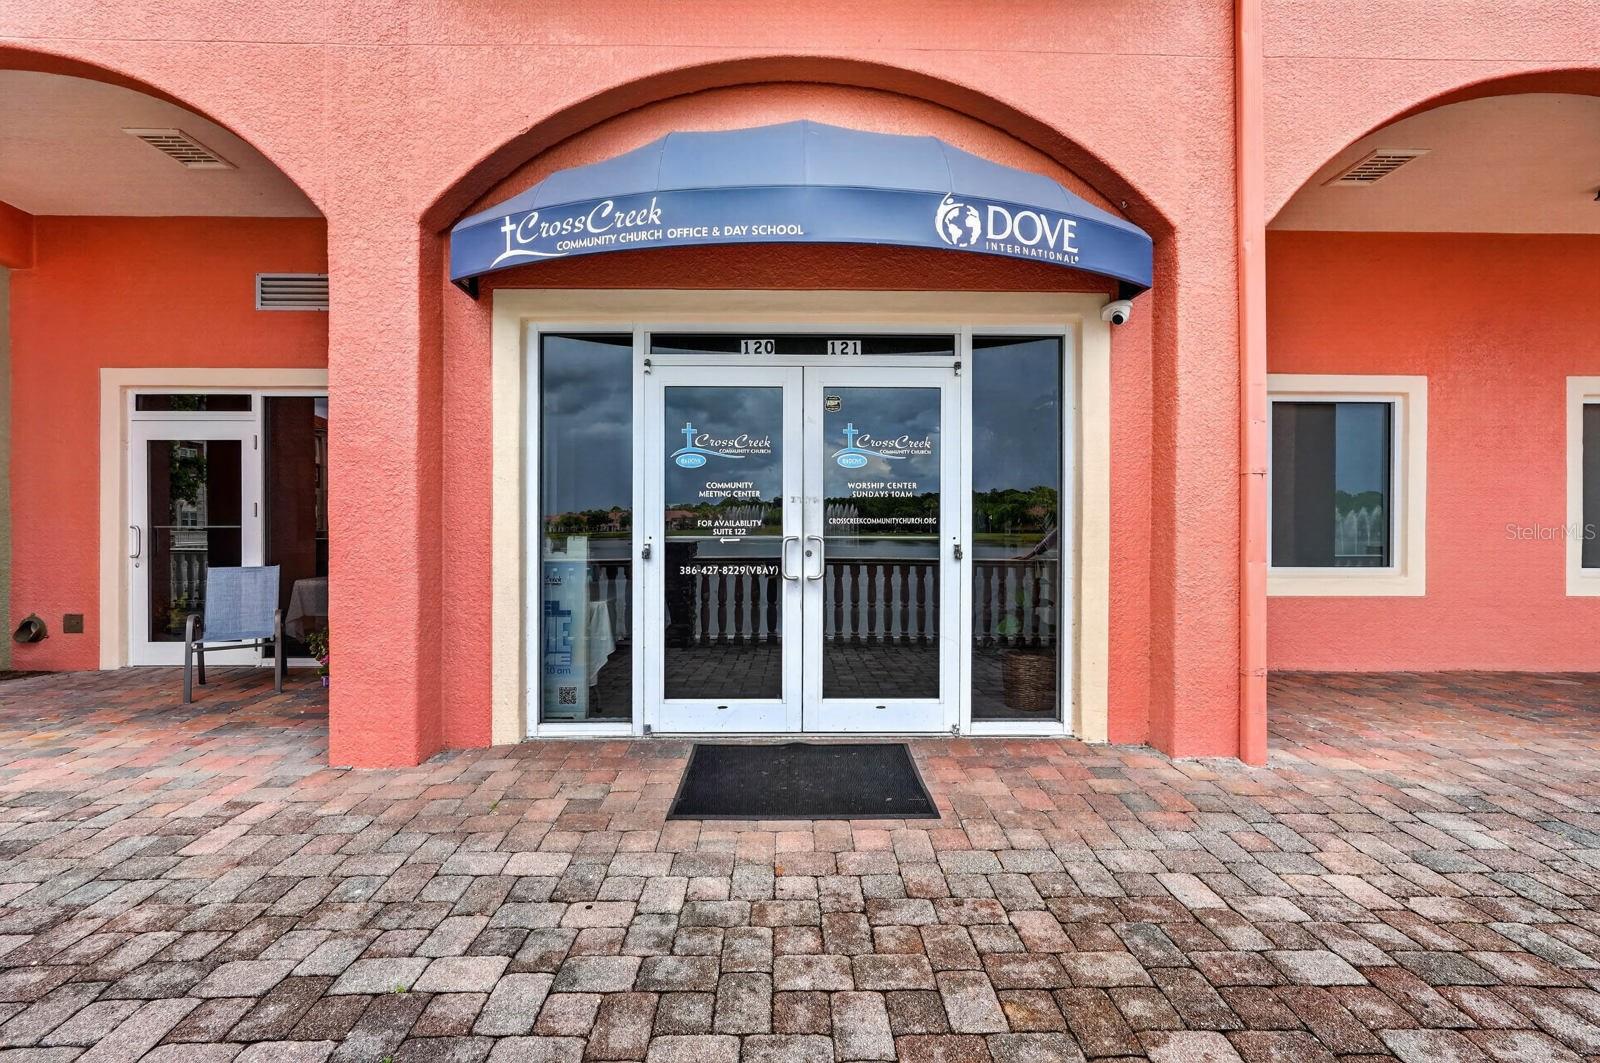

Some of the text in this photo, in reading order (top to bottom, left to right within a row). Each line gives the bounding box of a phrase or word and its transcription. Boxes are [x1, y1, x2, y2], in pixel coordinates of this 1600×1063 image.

[516, 197, 662, 244] CrossCreek
[986, 205, 1079, 253] DOVE
[556, 224, 804, 251] COMMUNITY CHURCH OFFICE & DAY SCHOOL
[743, 340, 774, 355] 120
[830, 341, 859, 355] 121
[695, 433, 771, 449] CrossCreek
[856, 434, 931, 449] CrossCreek
[828, 517, 937, 525] CROSSCREEKCOMMUNITYCHURCH.ORG
[680, 565, 779, 575] 386-427-8229(VBAY)
